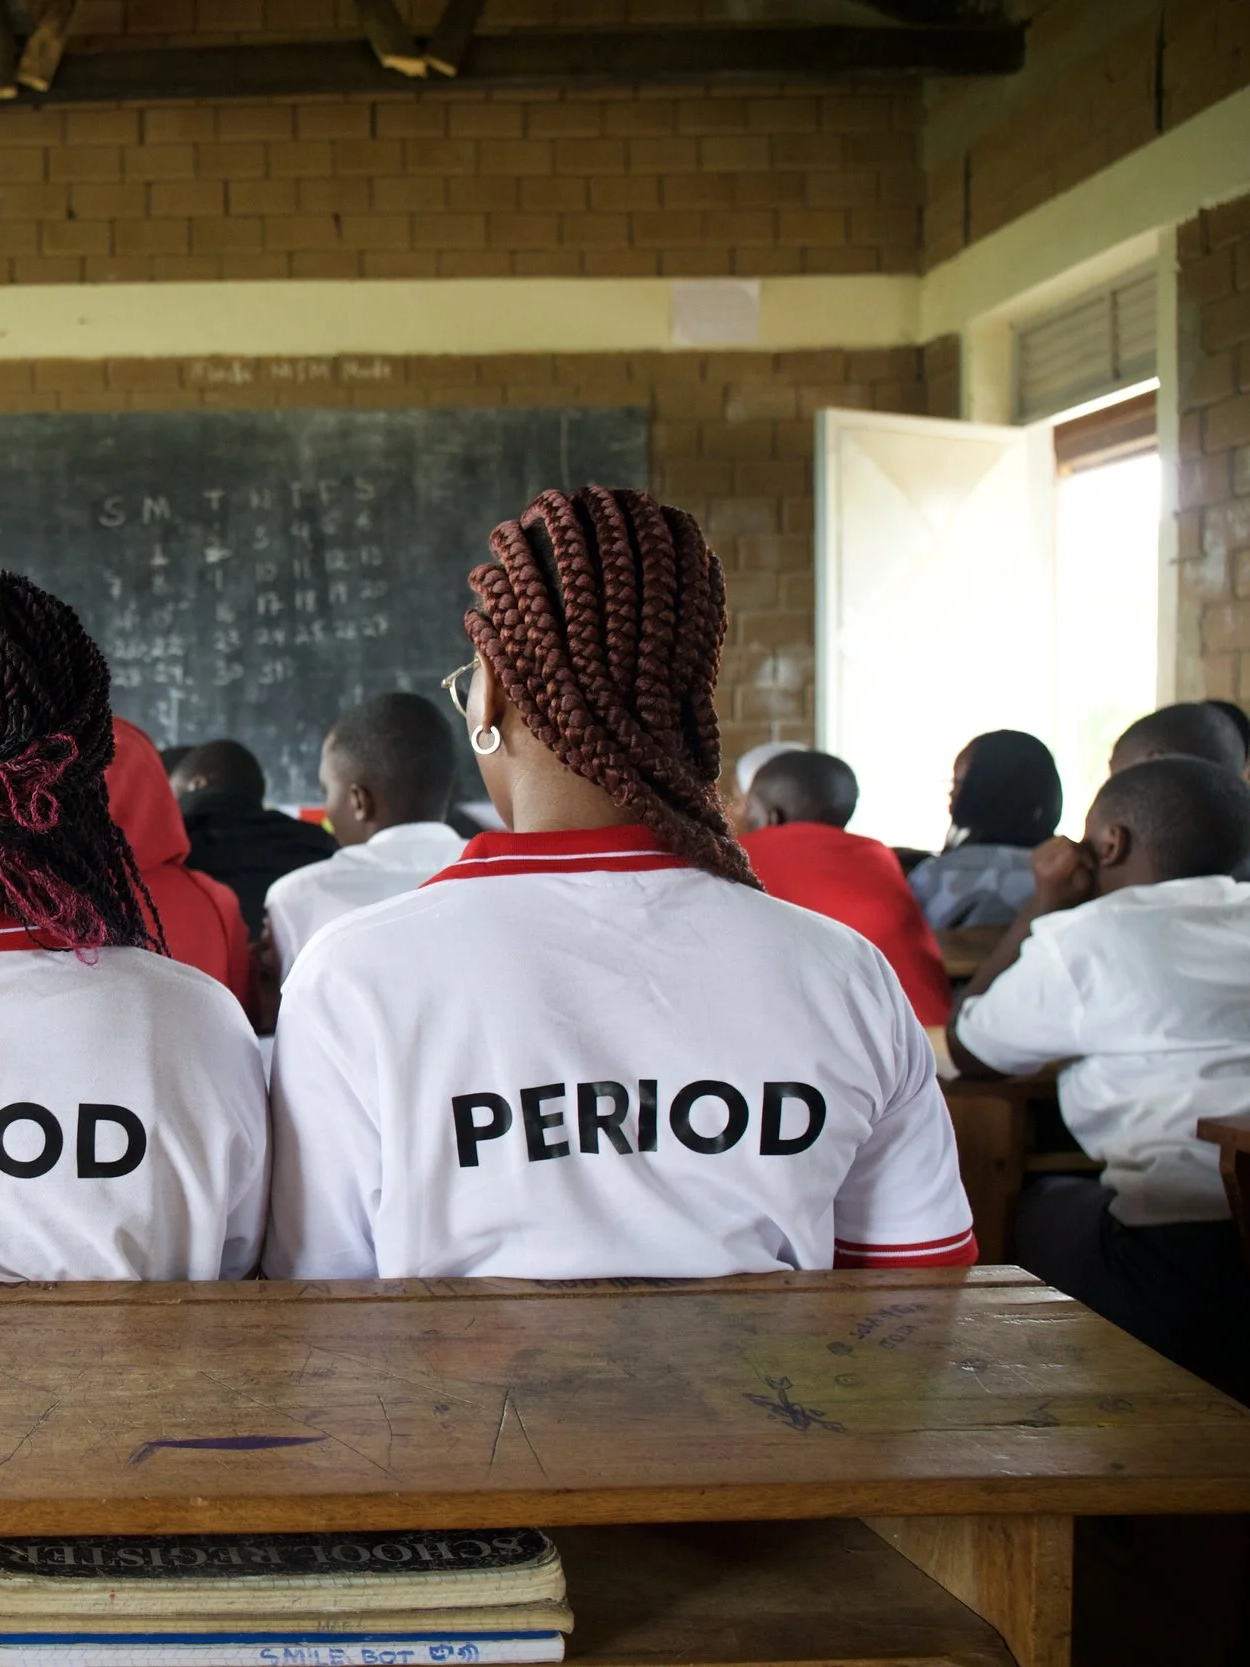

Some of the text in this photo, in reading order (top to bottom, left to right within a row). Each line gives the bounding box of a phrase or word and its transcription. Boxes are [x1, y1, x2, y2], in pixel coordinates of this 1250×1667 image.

[451, 1079, 827, 1168] PERIOD
[5, 1536, 524, 1567] SCHOOL REGISTER
[259, 1646, 415, 1667] SMILE BOT
